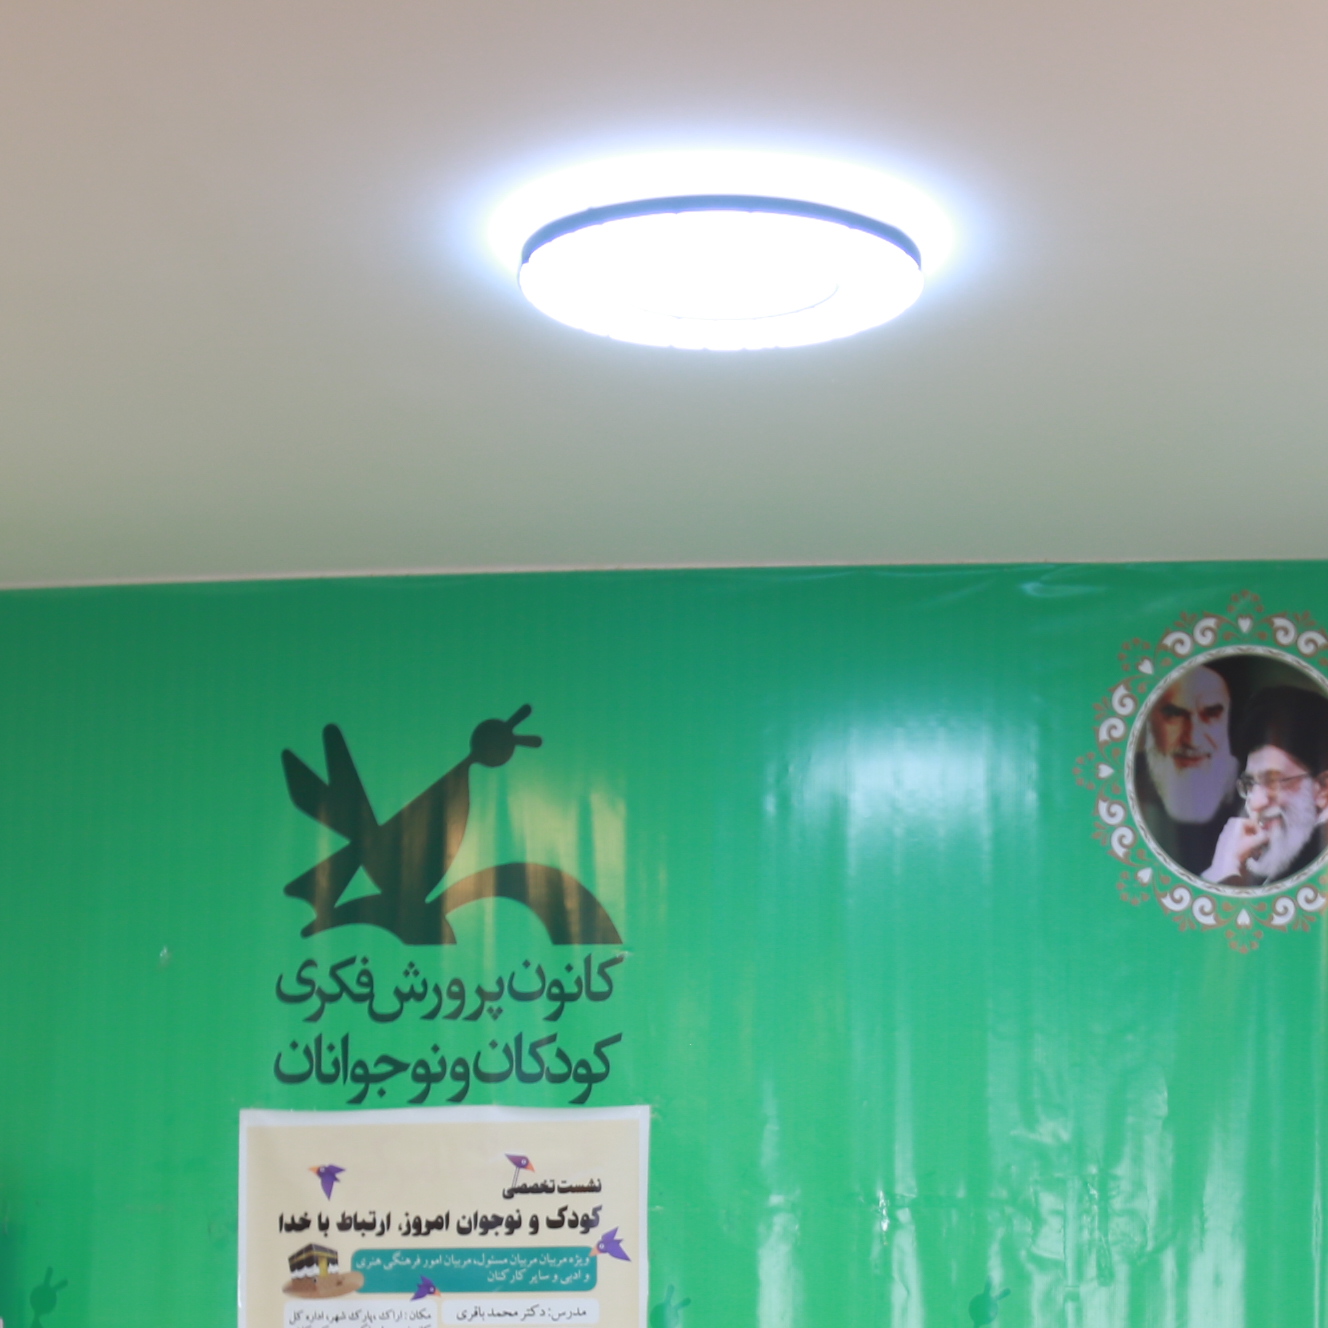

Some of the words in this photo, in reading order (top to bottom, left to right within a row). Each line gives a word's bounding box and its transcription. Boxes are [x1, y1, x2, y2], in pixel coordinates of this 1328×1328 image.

[275, 955, 374, 1022] فکری
[367, 961, 504, 1022] پرورش
[506, 953, 624, 1021] کانون
[273, 1031, 448, 1104] نوجوانان
[446, 1054, 471, 1103] و
[473, 1031, 623, 1104] کودکان
[502, 1179, 555, 1199] تخصصی
[557, 1178, 602, 1194] نشست
[279, 1211, 312, 1234] خدا
[317, 1211, 330, 1237] با
[336, 1210, 391, 1237] ارتباط
[456, 1208, 522, 1236] نوجوان
[528, 1213, 539, 1235] و
[546, 1205, 602, 1234] کودک
[356, 1256, 382, 1270] هنری
[383, 1252, 421, 1270] فرهنگی
[529, 1270, 549, 1284] سایر
[560, 1270, 581, 1284] ادبی
[456, 1305, 485, 1322] باقری
[487, 1308, 518, 1318] محمد
[522, 1304, 546, 1321] دکتر
